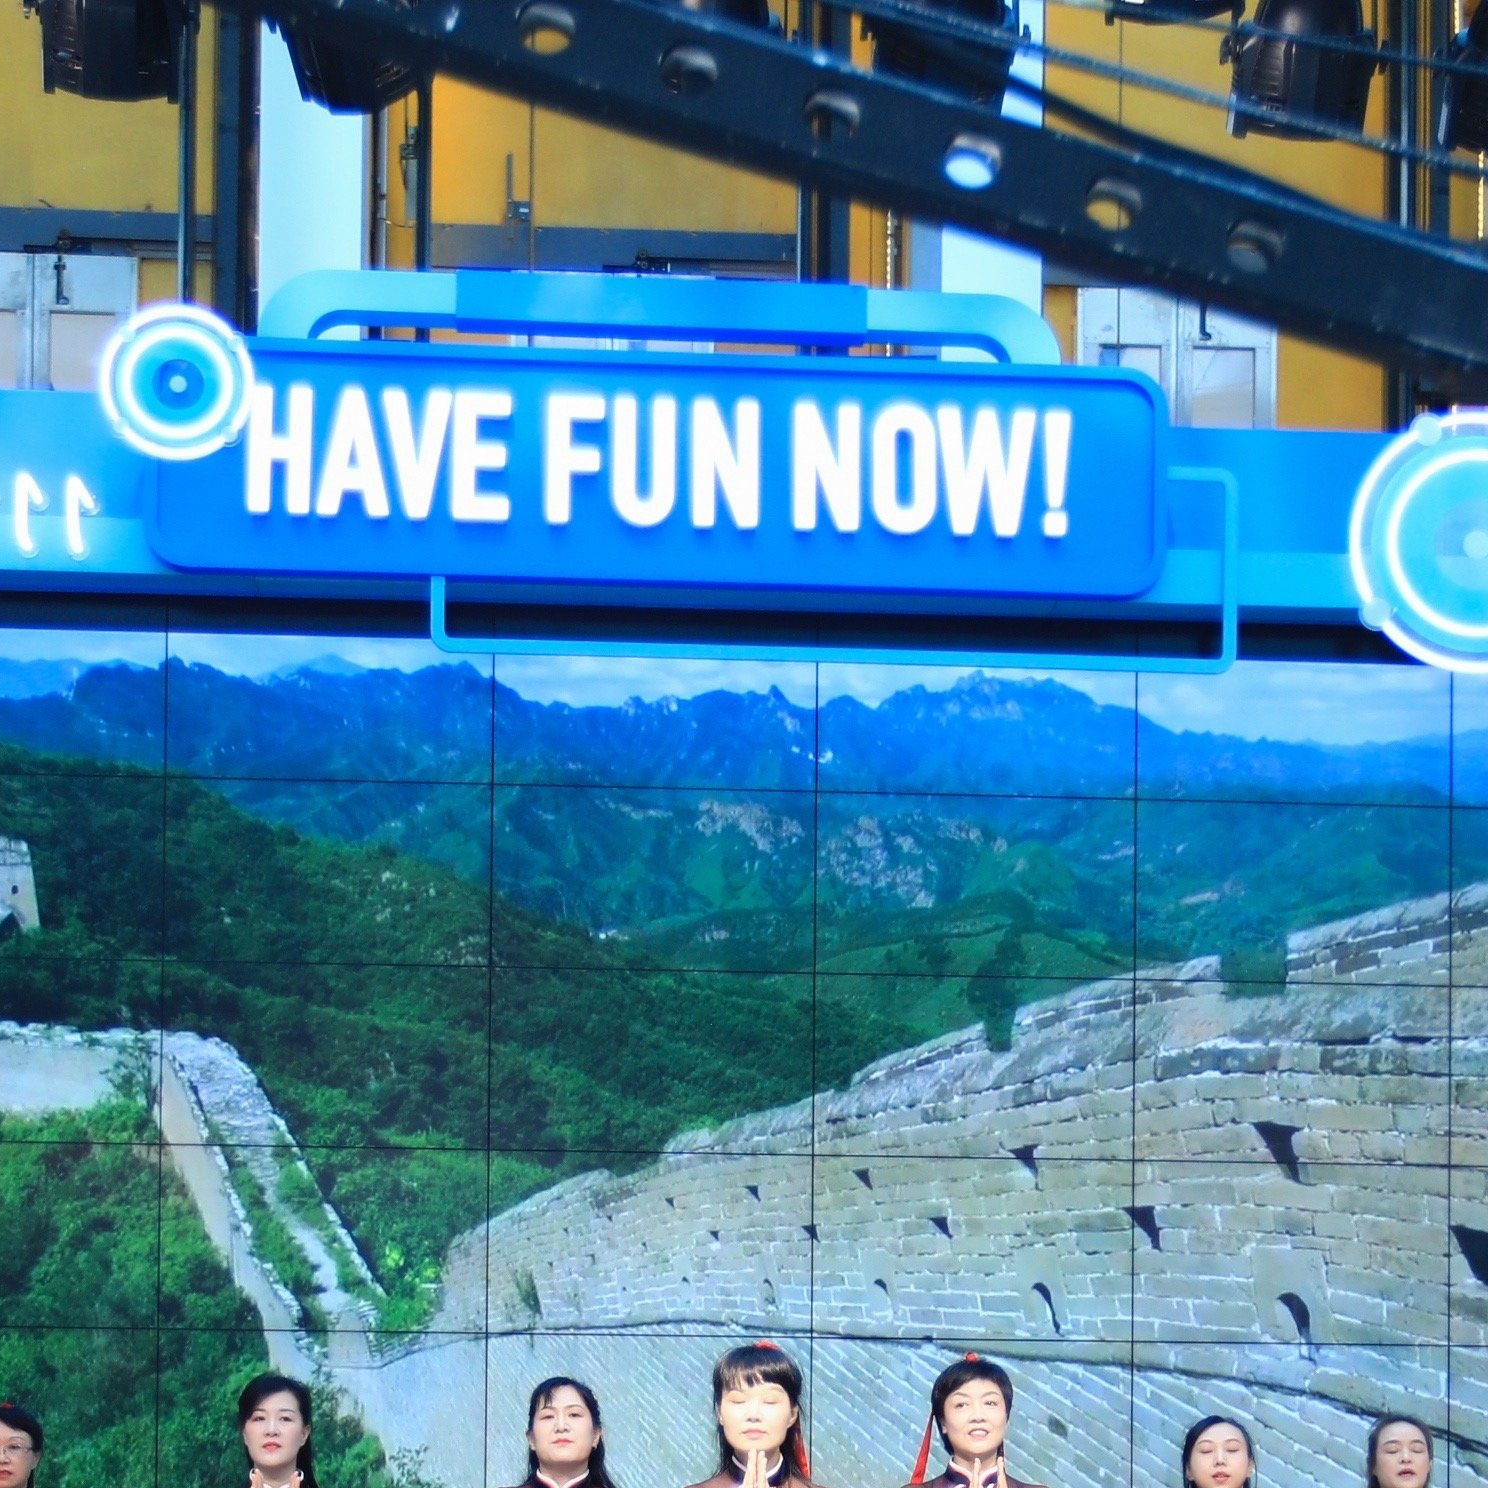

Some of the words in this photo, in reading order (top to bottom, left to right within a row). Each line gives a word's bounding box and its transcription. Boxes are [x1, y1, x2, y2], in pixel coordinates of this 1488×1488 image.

[243, 381, 512, 524] HAVE
[543, 392, 759, 531] FUN
[792, 399, 1073, 539] NOW!
